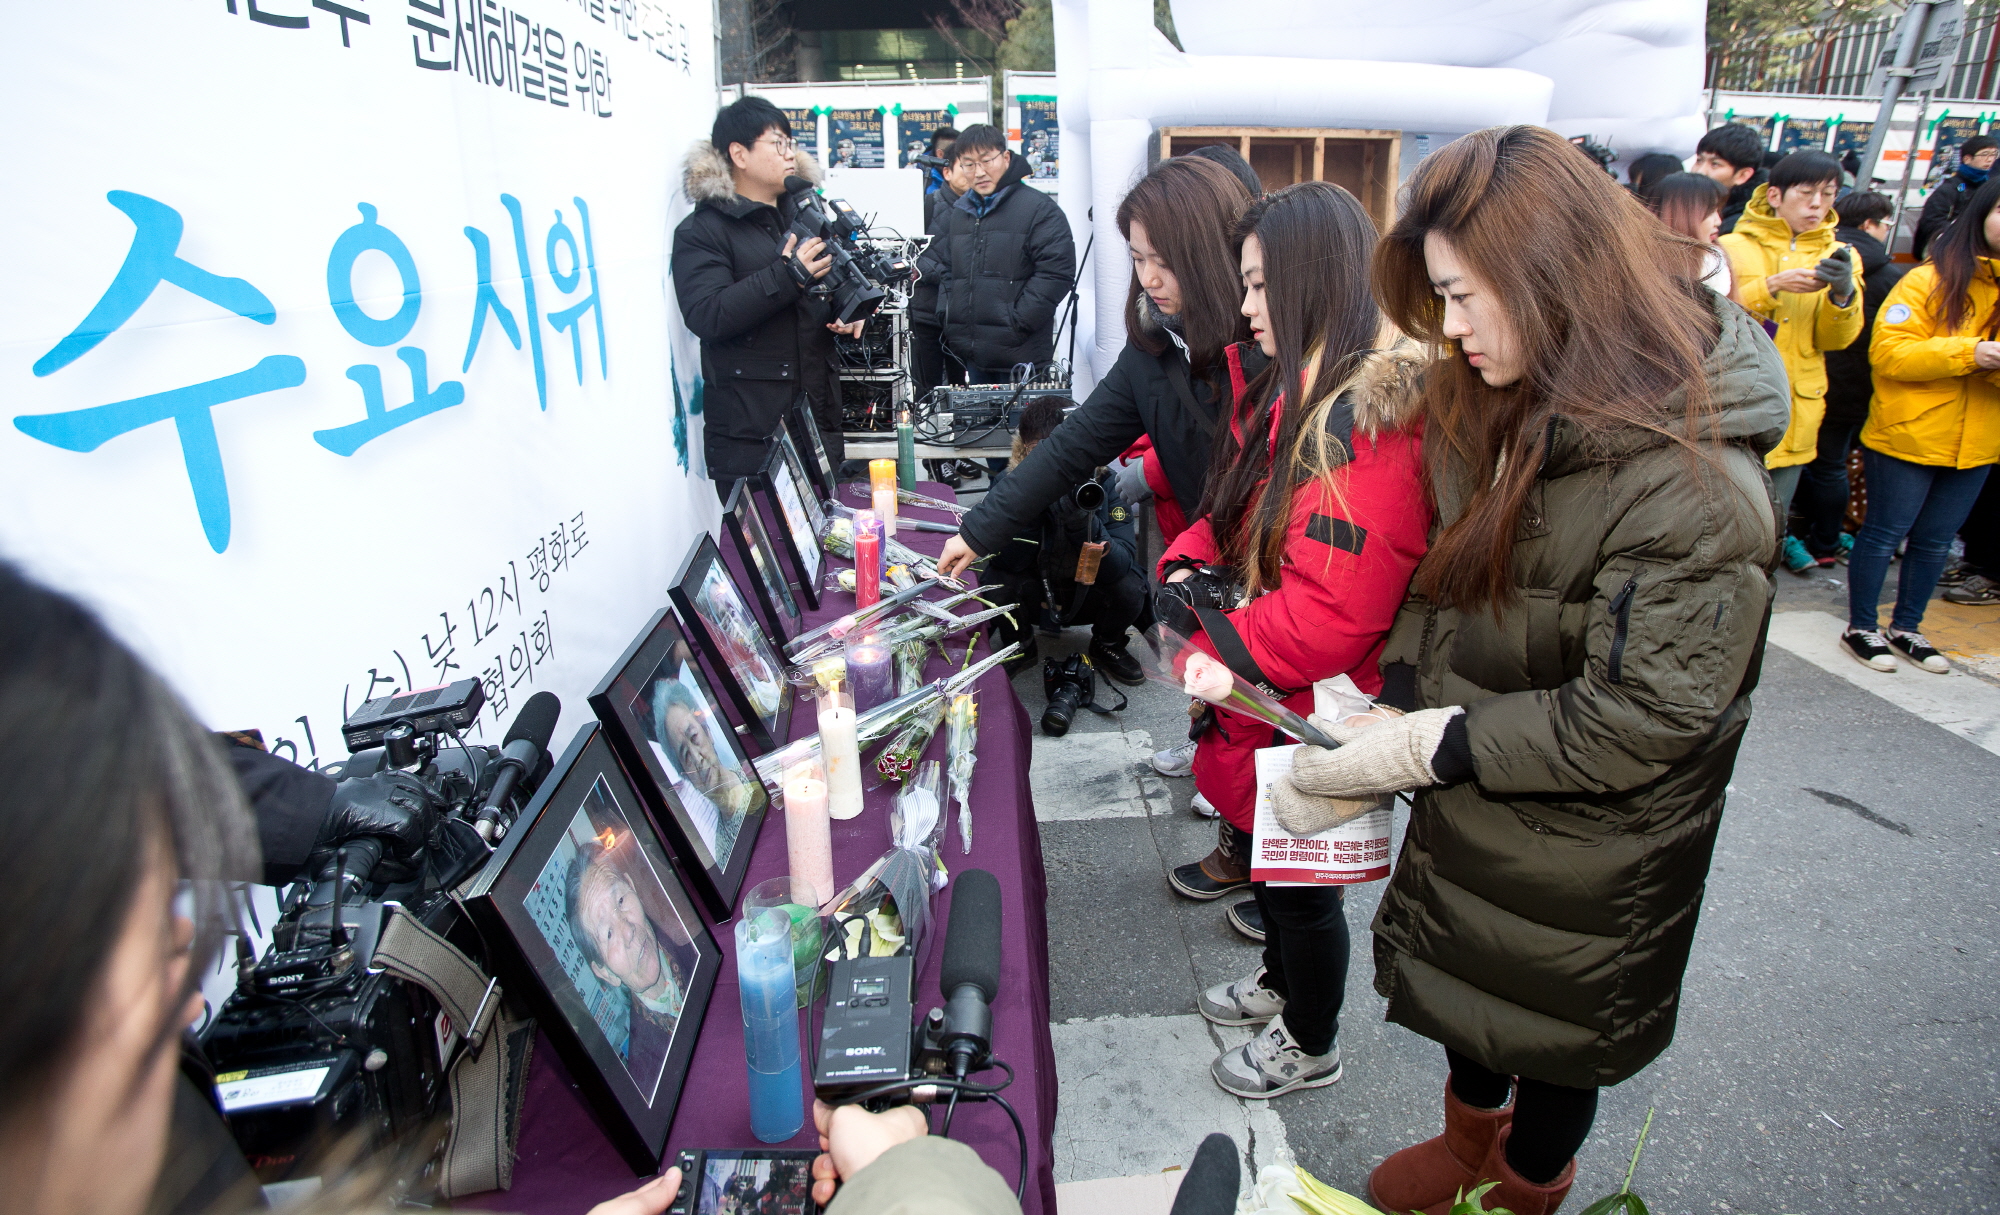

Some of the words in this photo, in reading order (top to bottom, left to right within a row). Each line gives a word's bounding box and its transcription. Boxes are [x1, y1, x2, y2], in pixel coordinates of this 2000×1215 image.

[574, 41, 612, 118] 위한
[13, 189, 607, 554] 수요시위
[421, 611, 460, 686] 낮
[467, 560, 521, 647] 12시
[526, 511, 589, 593] 평화로
[1262, 839, 1288, 848] 탄핵은
[1290, 838, 1330, 851] 기만이다,
[1334, 840, 1363, 851] 박근혜는
[1262, 851, 1287, 861] 국민의
[1289, 850, 1330, 863] 명령이다,
[1333, 853, 1362, 863] 박근혜는
[269, 974, 304, 984] SONY
[845, 1047, 881, 1056] SONY
